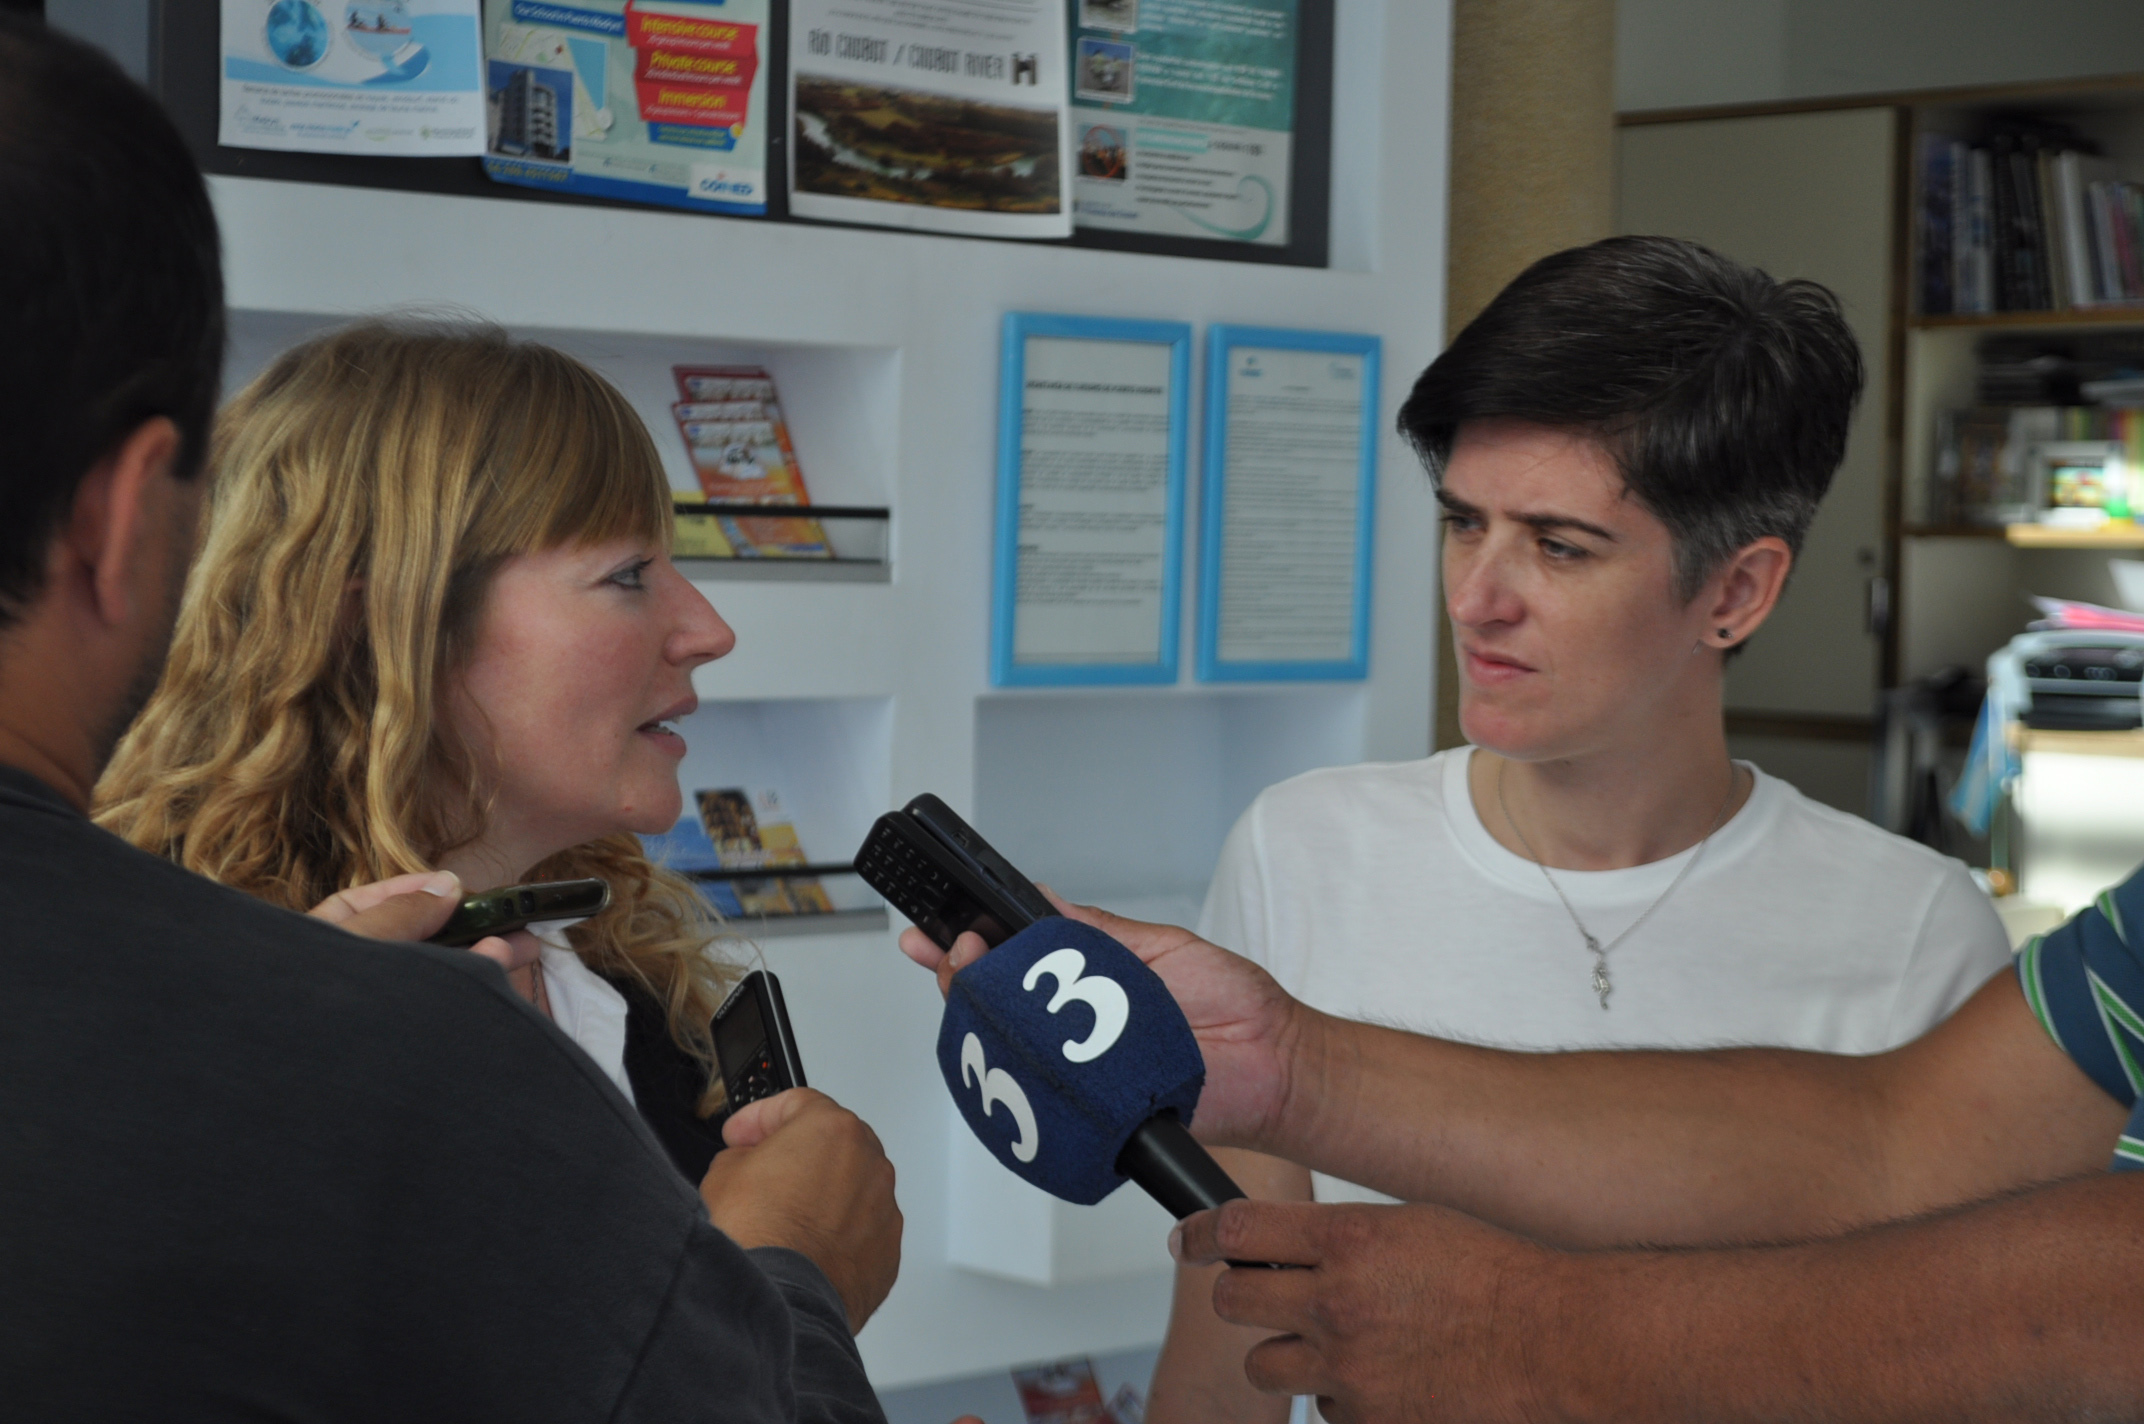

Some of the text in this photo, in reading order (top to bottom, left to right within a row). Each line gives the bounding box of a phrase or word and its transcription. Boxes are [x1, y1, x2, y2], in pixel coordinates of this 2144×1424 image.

[641, 16, 738, 41] Intensive course
[650, 50, 738, 75] Private course
[963, 52, 1004, 80] RIVER
[658, 89, 727, 108] Immersion
[716, 983, 745, 1020] OLYMPUS
[1022, 948, 1129, 1063] 3
[960, 1031, 1039, 1163] 3
